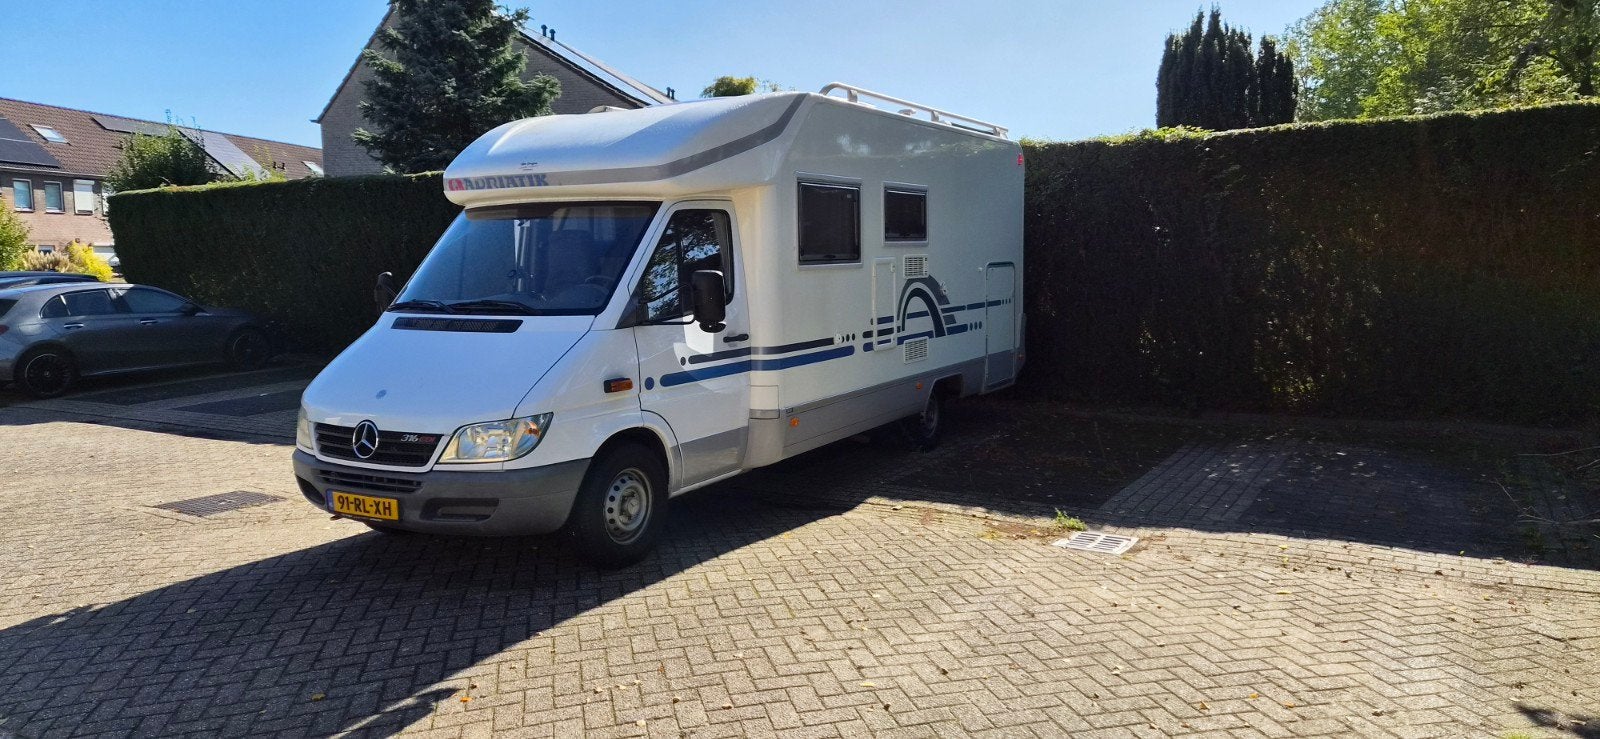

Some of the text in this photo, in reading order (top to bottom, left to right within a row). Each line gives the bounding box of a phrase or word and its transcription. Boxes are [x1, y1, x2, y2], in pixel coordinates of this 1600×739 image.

[463, 174, 549, 190] ADRIATIK
[400, 434, 419, 442] 316
[337, 495, 392, 517] 91-RL-XH
